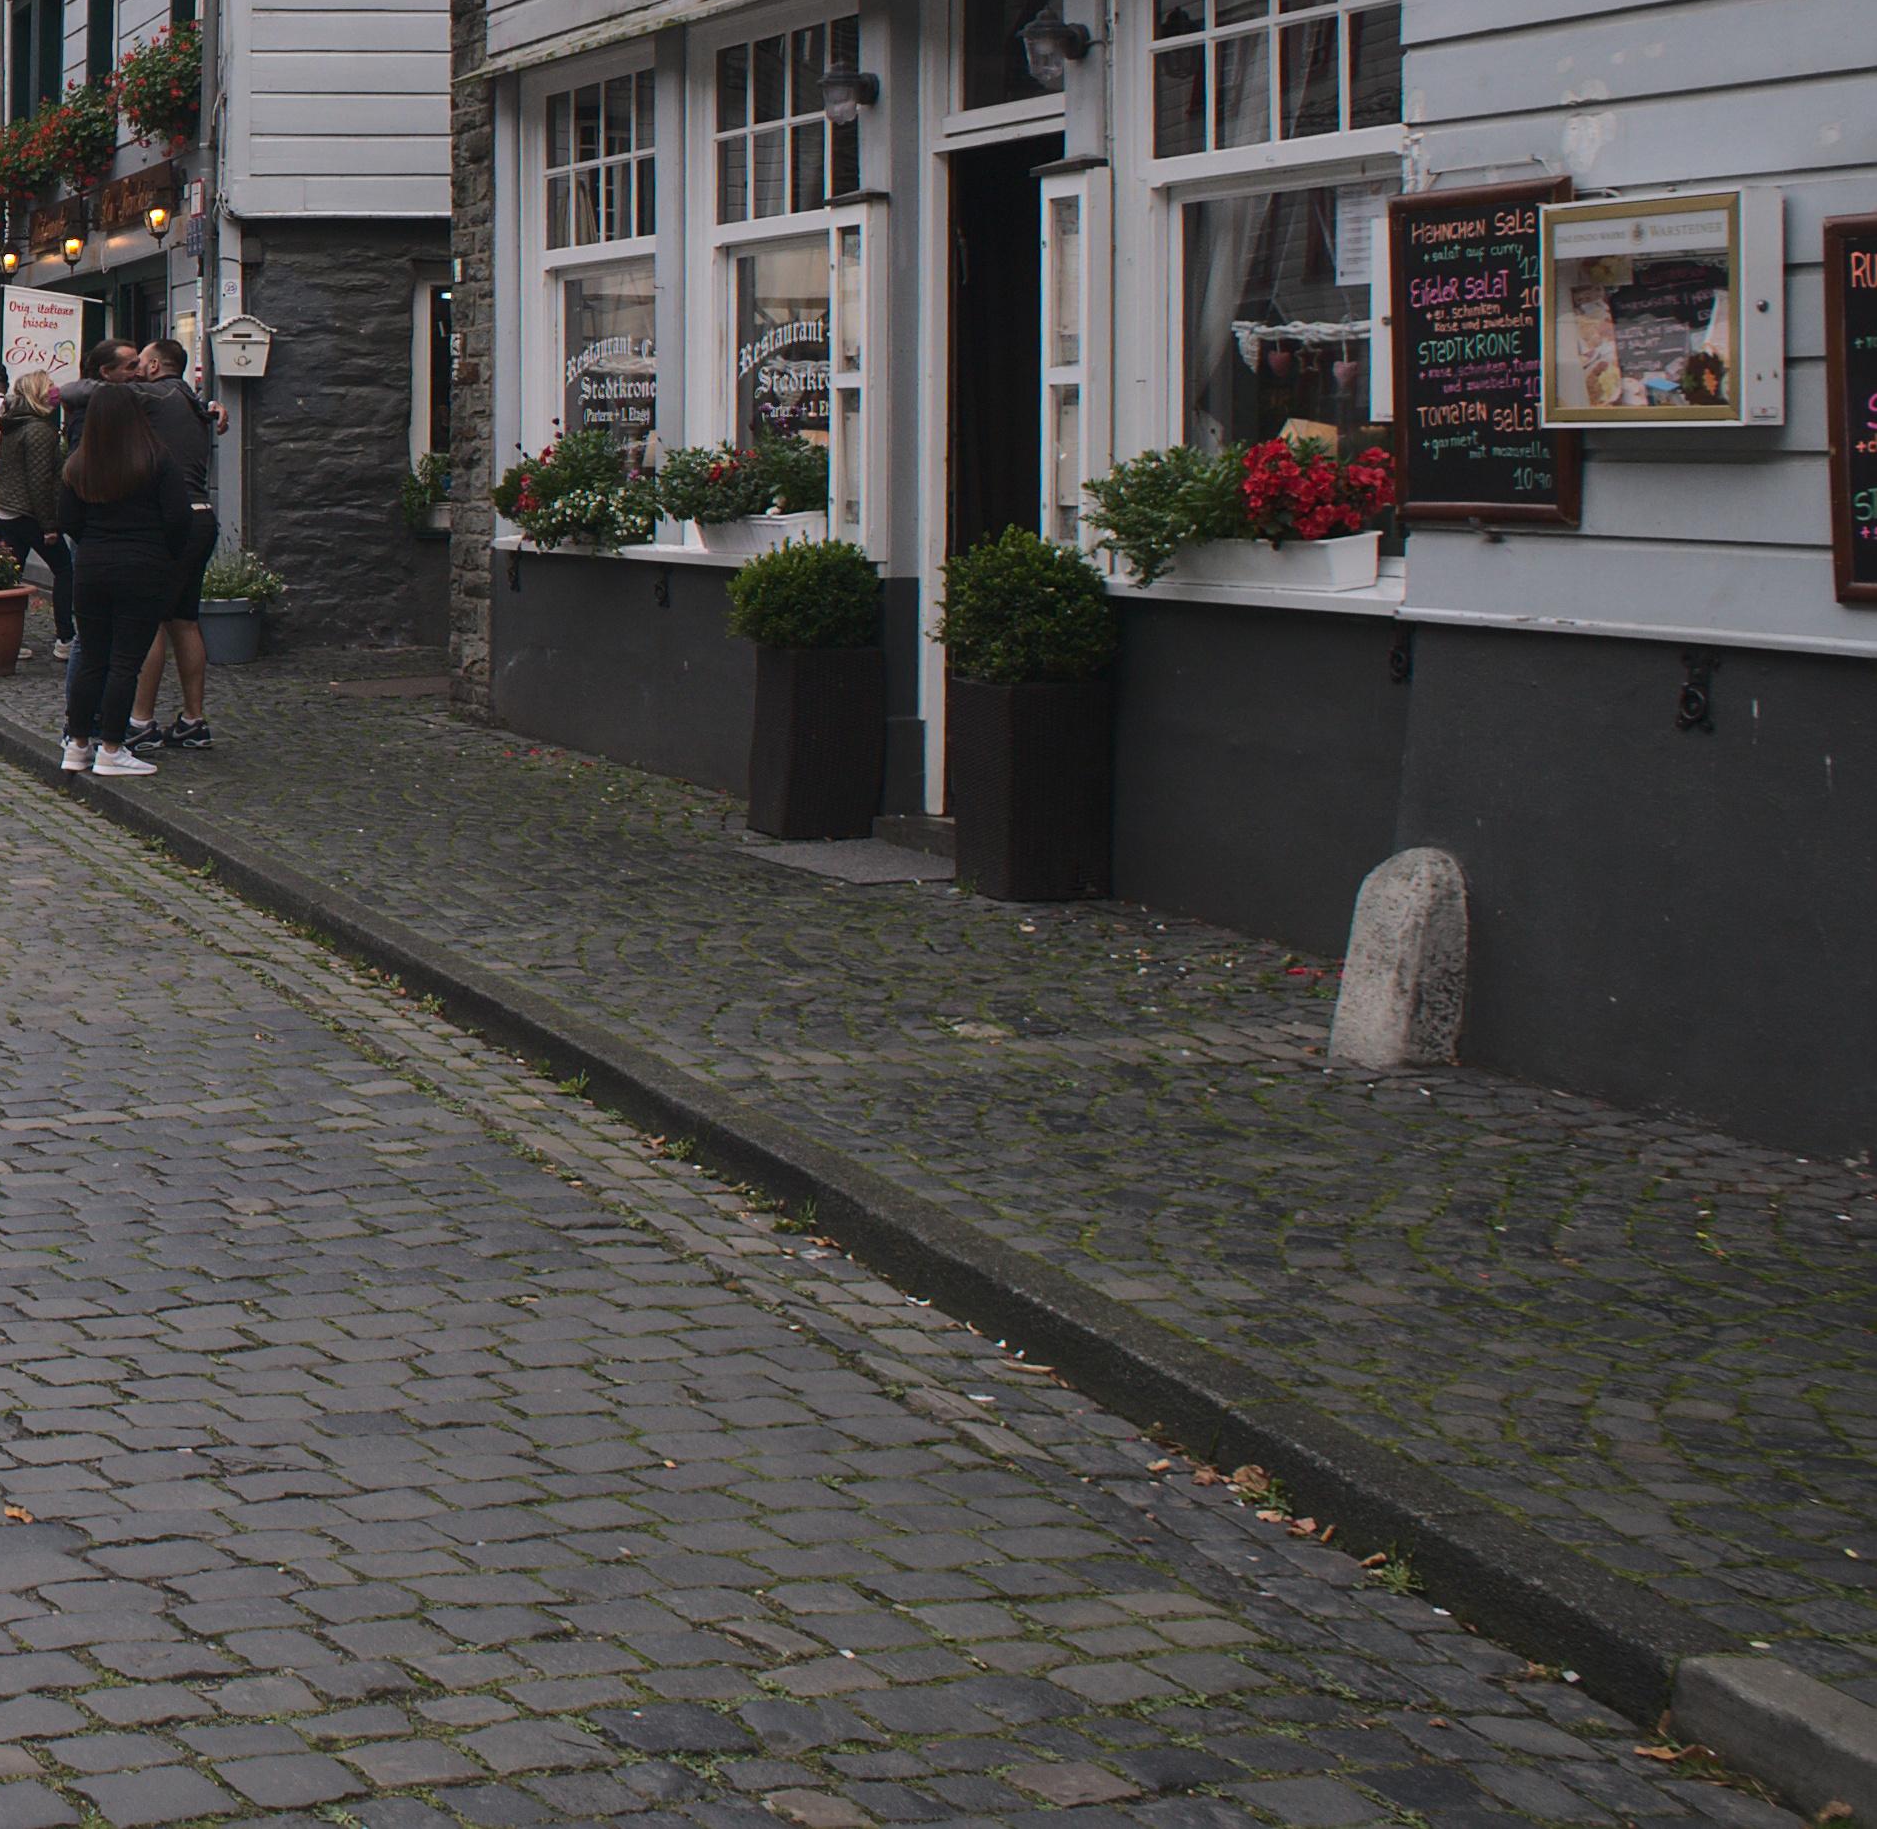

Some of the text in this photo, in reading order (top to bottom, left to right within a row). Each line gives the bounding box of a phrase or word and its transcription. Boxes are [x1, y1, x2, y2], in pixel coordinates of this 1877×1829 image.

[1649, 221, 1723, 238] WARSTEINER
[1490, 243, 1524, 262] curry
[1461, 318, 1480, 331] und
[5, 335, 47, 366] Eis
[566, 334, 632, 387] Restaurant
[738, 317, 824, 380] Restaurant
[577, 374, 656, 406] Stadtkrone
[1432, 430, 1479, 460] garniert
